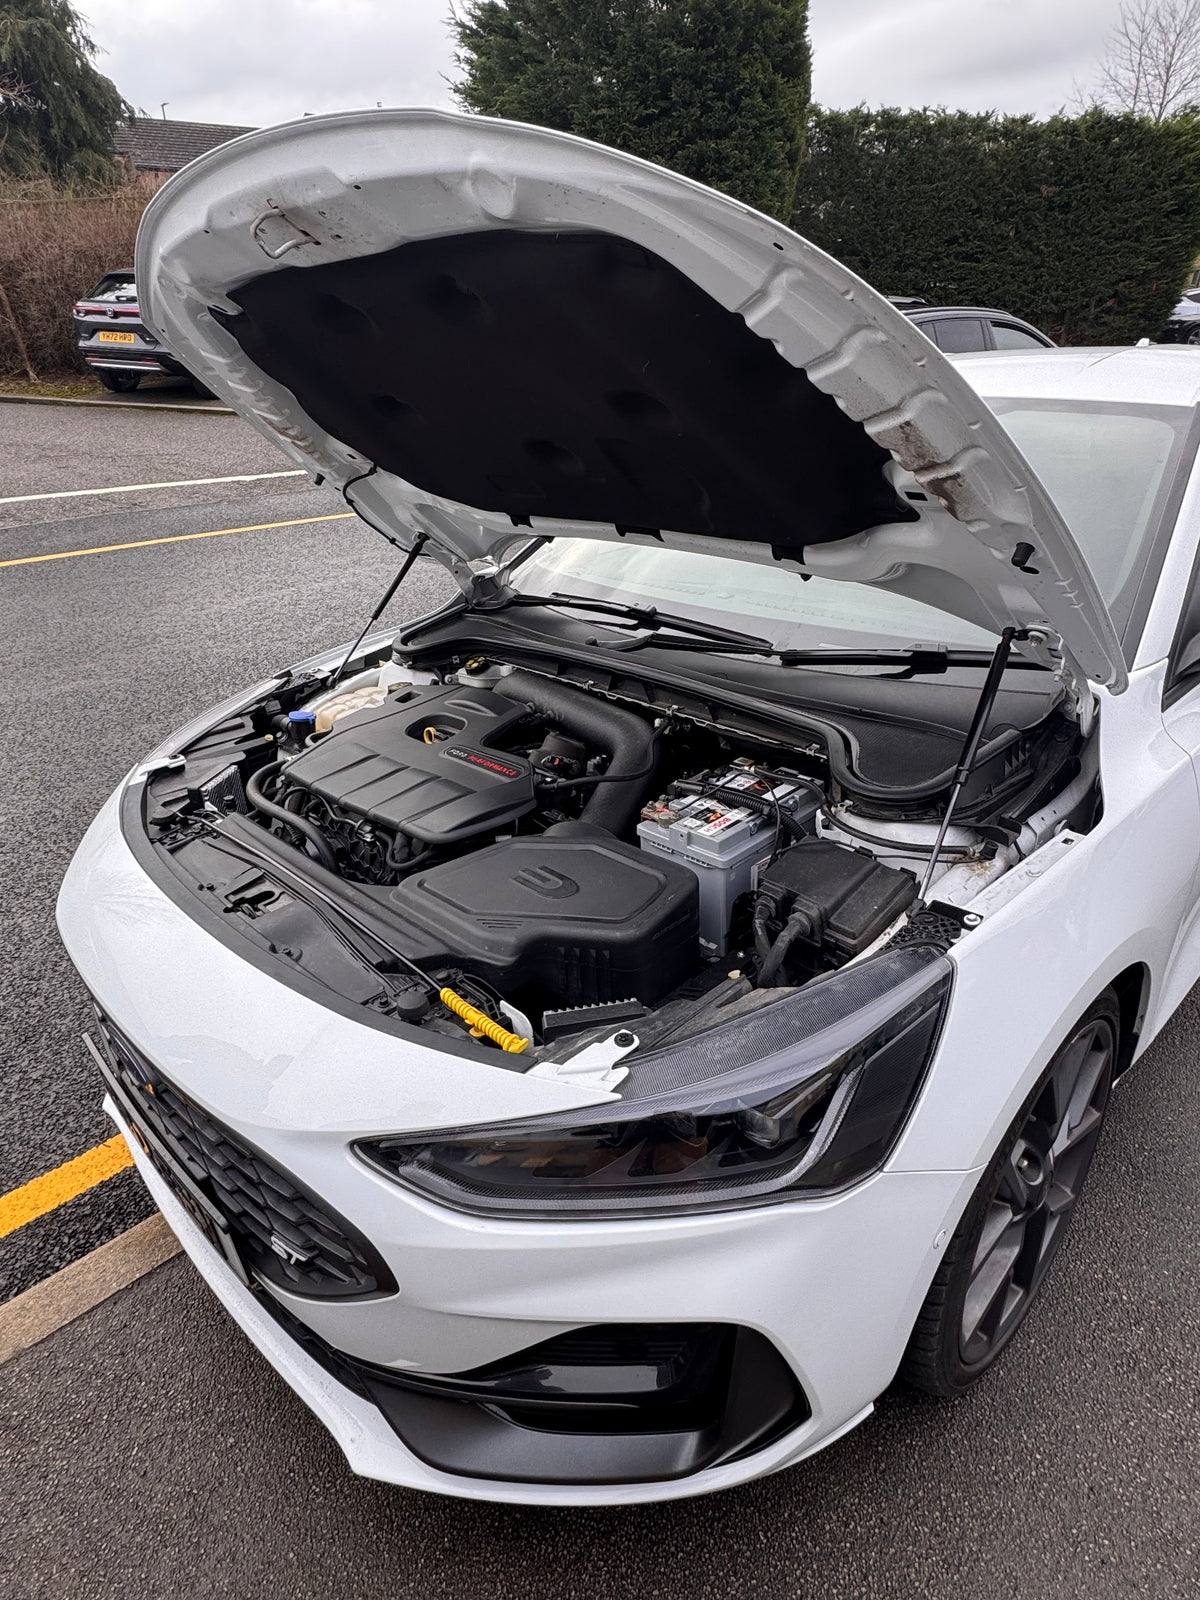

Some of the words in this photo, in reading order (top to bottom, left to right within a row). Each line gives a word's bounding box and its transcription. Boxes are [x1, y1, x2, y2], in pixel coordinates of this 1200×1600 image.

[449, 748, 468, 758] FORD
[467, 755, 517, 776] PERFORMANCE
[703, 817, 732, 833] BOSCH
[270, 1235, 308, 1265] ST
